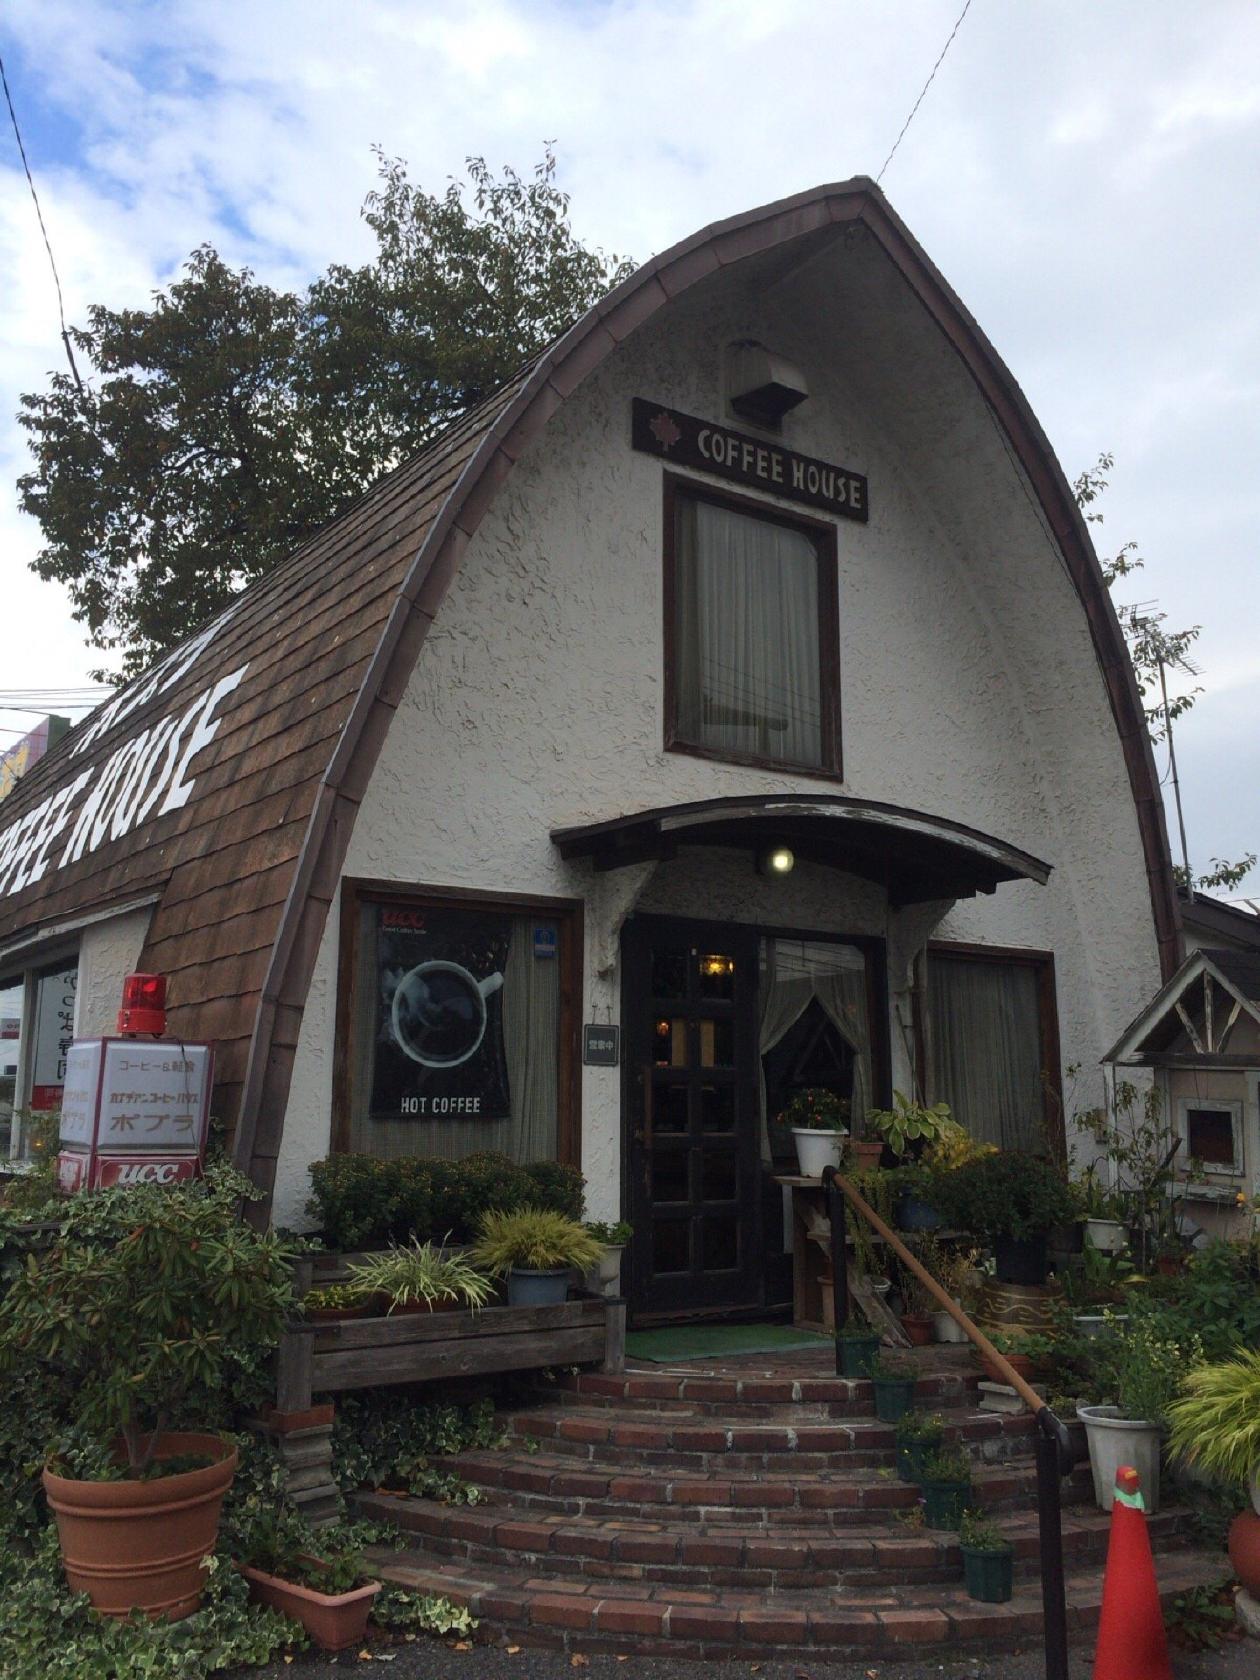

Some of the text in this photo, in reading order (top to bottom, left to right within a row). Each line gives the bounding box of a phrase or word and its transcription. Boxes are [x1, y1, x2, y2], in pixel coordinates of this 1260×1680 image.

[697, 428, 862, 509] COFFEE HOUSE
[401, 1097, 481, 1113] HOT COFFEE
[110, 1113, 194, 1132] ポプラ
